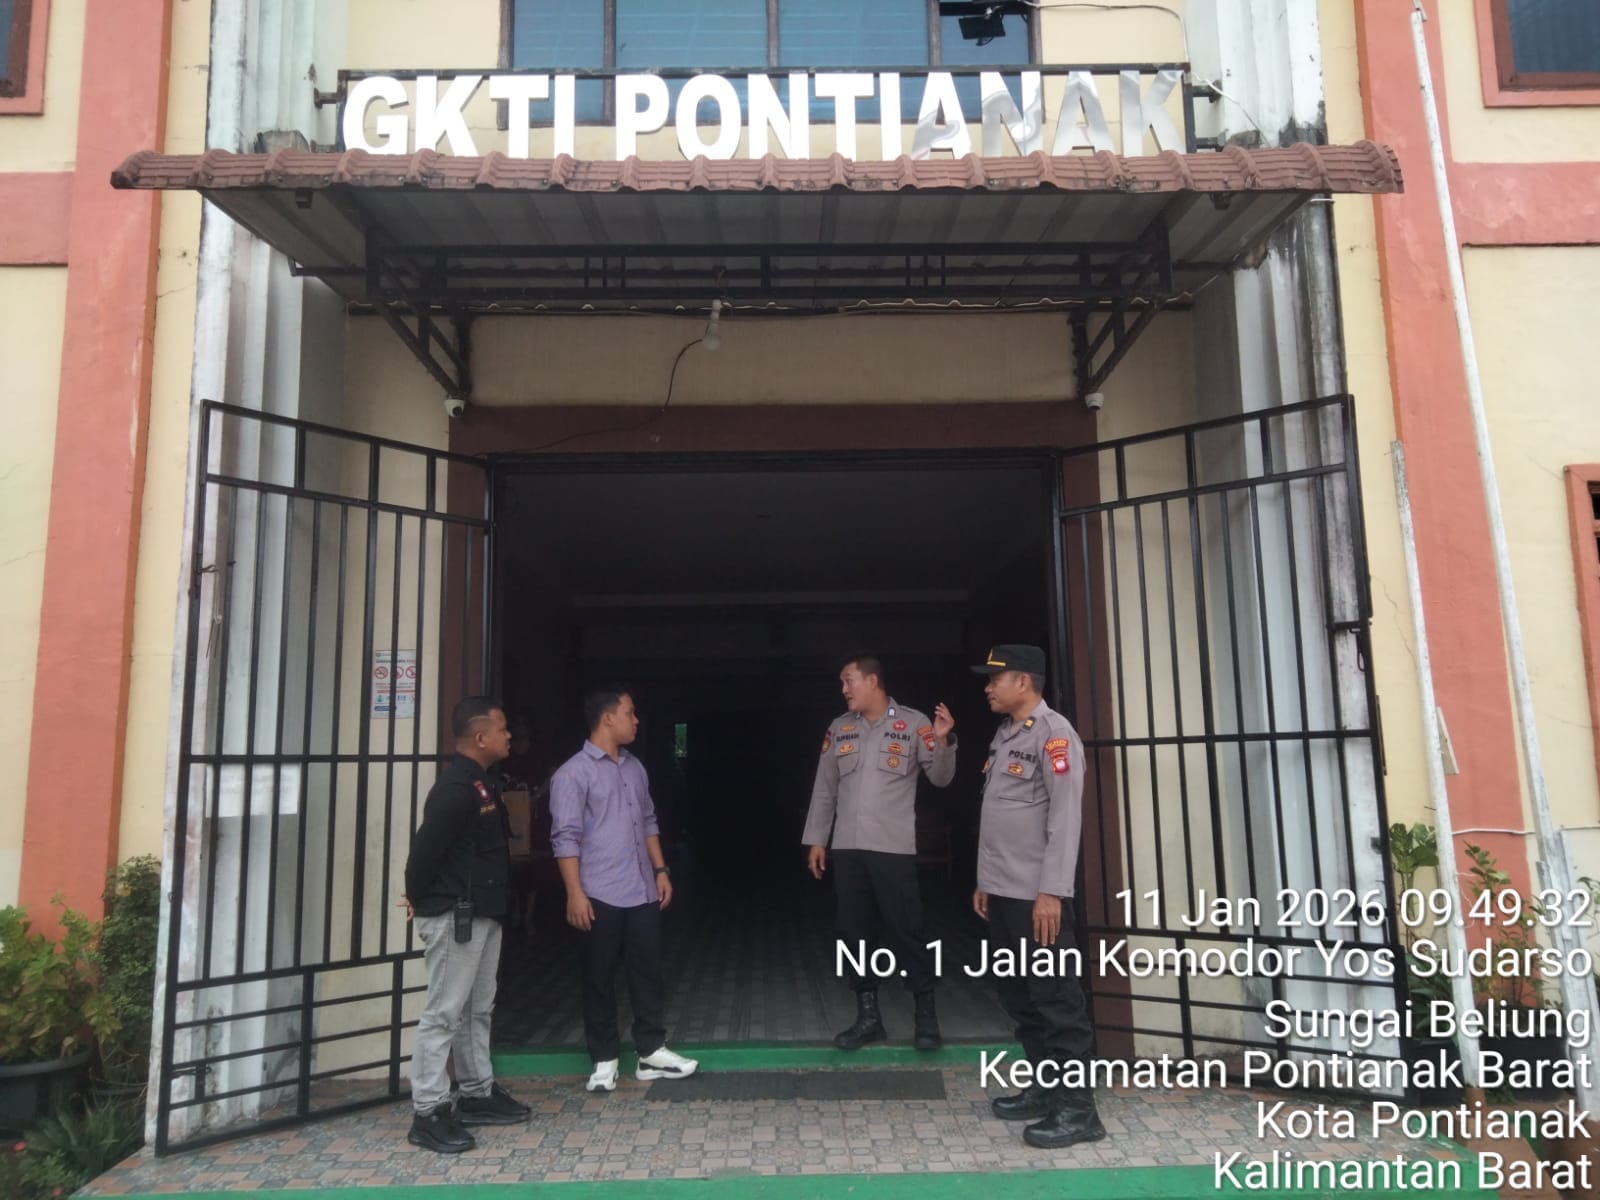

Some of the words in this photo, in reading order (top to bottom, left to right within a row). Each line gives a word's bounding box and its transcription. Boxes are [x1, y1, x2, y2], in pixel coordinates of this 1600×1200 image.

[343, 73, 576, 160] GKTI
[615, 70, 1184, 162] PONTIANAK
[884, 731, 911, 742] POLRI
[1008, 750, 1036, 763] POLRI
